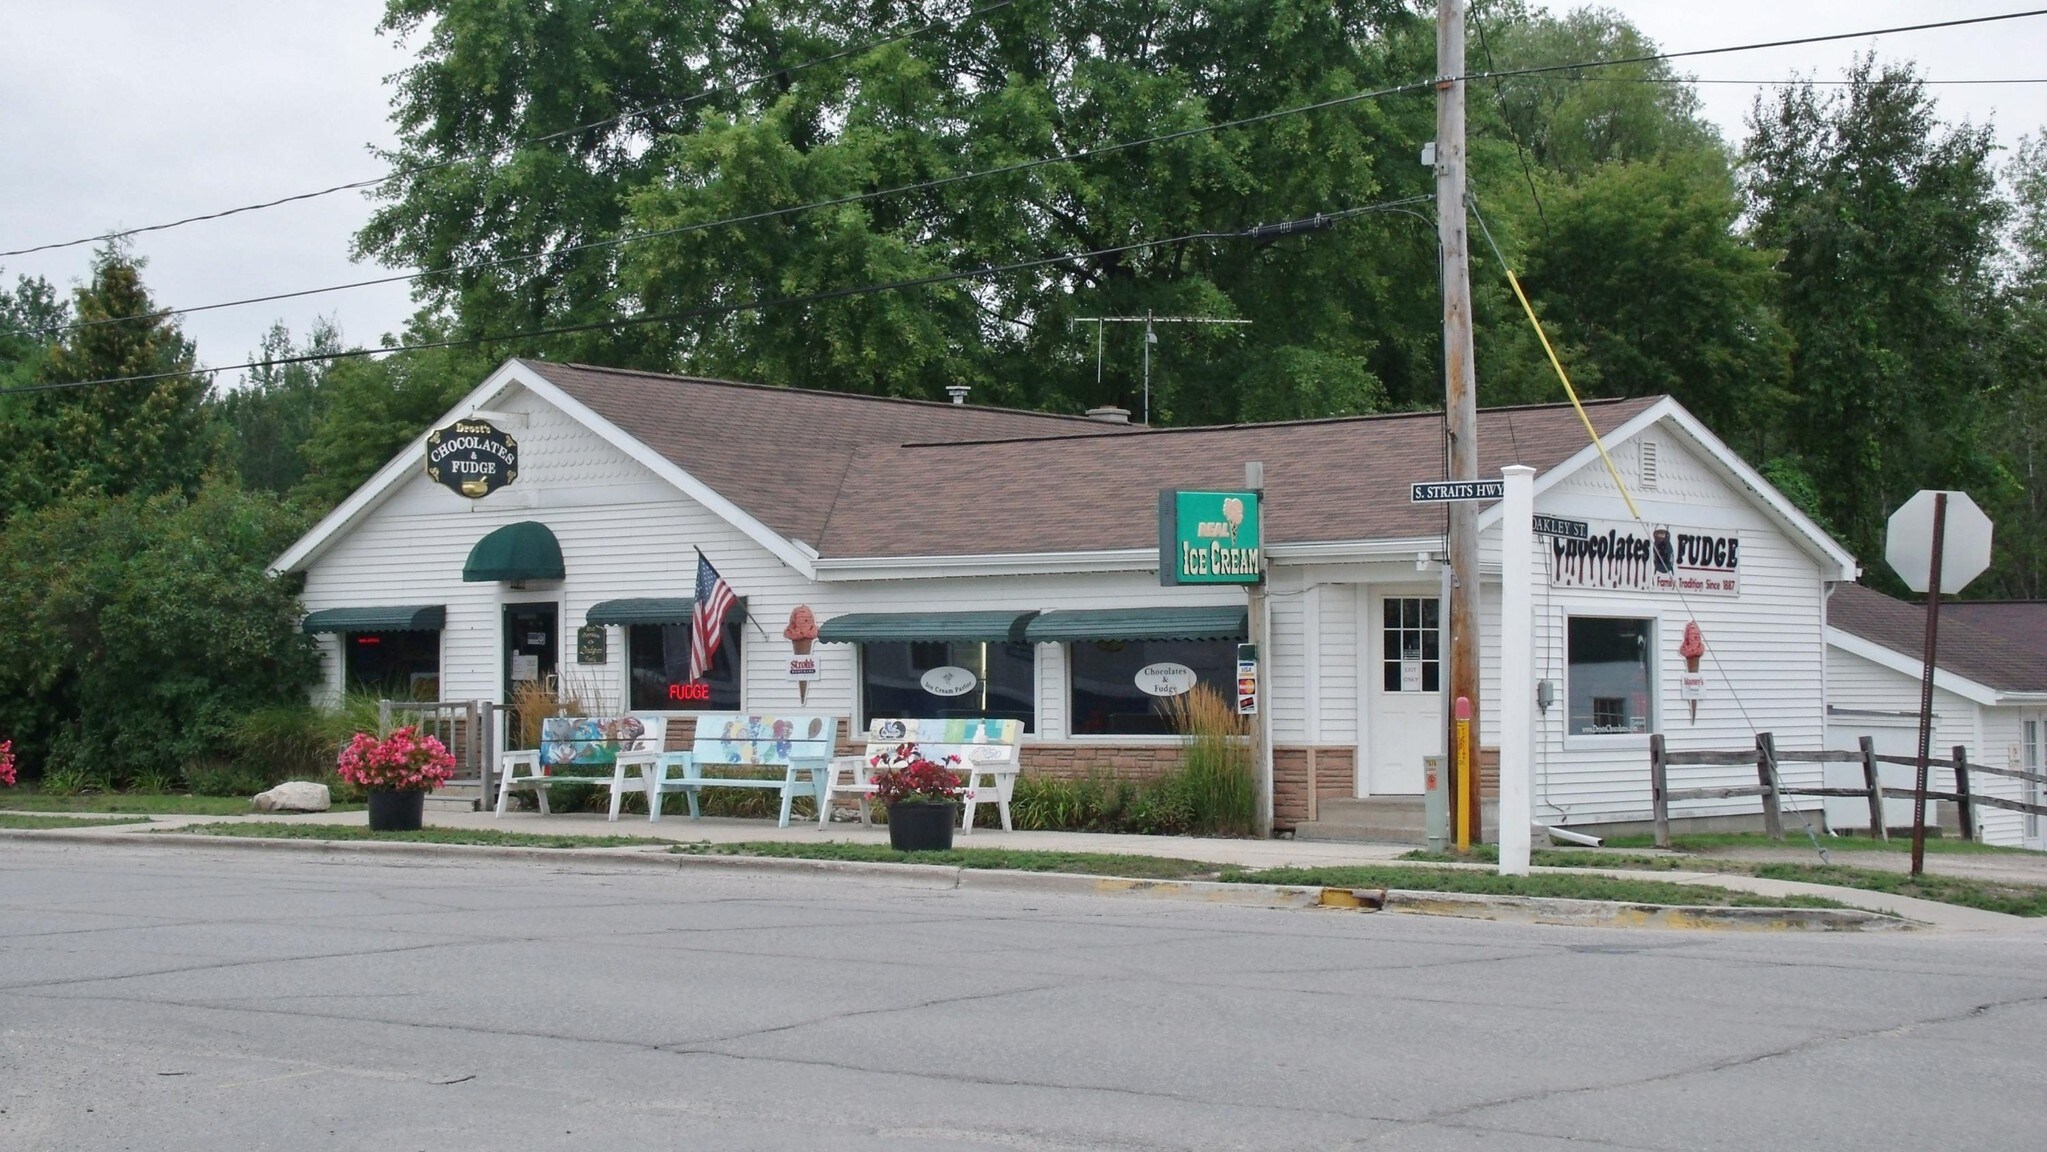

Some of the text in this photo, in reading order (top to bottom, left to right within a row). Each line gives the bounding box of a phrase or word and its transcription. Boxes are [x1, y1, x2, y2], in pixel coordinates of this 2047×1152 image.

[456, 422, 491, 434] Drost's
[431, 436, 515, 465] CHOCOLATES
[470, 451, 478, 460] &
[451, 461, 496, 474] FUDGE
[1415, 487, 1424, 499] S.
[1427, 484, 1473, 499] STRAITS
[1573, 523, 1586, 537] ST.
[1677, 534, 1739, 568] FUDGE
[1657, 576, 1736, 591] Family Tradition Since 1887
[1144, 667, 1187, 676] Chocolates
[669, 685, 709, 700] FUDGE
[934, 686, 954, 694] Cream
[1154, 685, 1178, 695] Fudge
